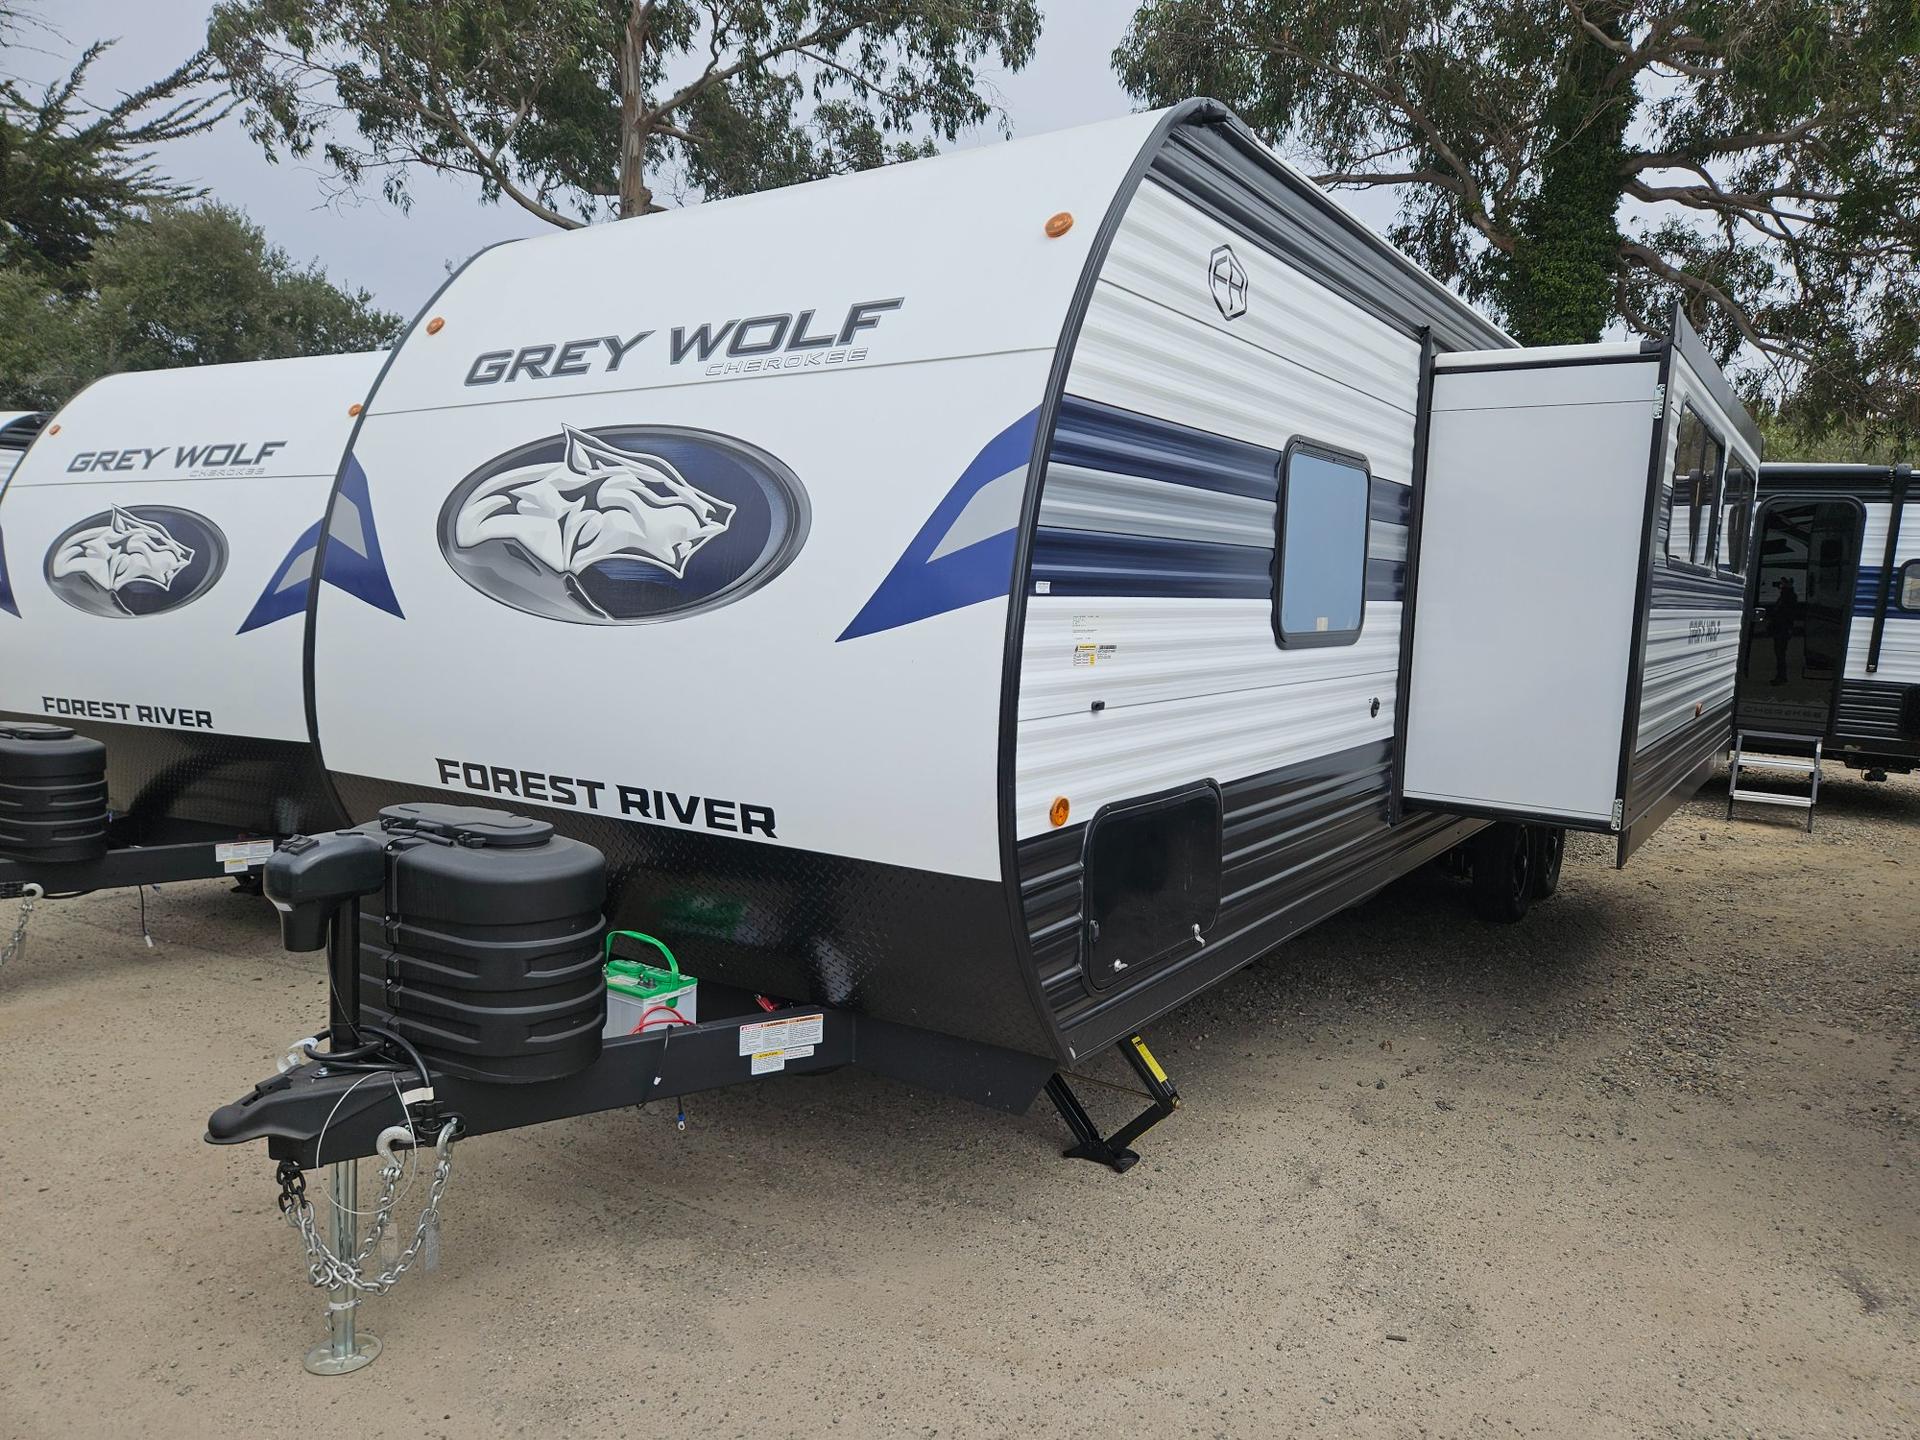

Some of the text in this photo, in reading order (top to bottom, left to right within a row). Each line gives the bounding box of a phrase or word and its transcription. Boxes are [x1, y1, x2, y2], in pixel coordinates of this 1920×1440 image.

[464, 296, 905, 387] GREY WOLF
[705, 347, 869, 376] CHEROKEE
[66, 440, 288, 473] GREY WOLF
[189, 467, 266, 478] CHEROKEE
[42, 696, 214, 729] FOREST RIVER
[435, 758, 778, 839] FOREST RIVER
